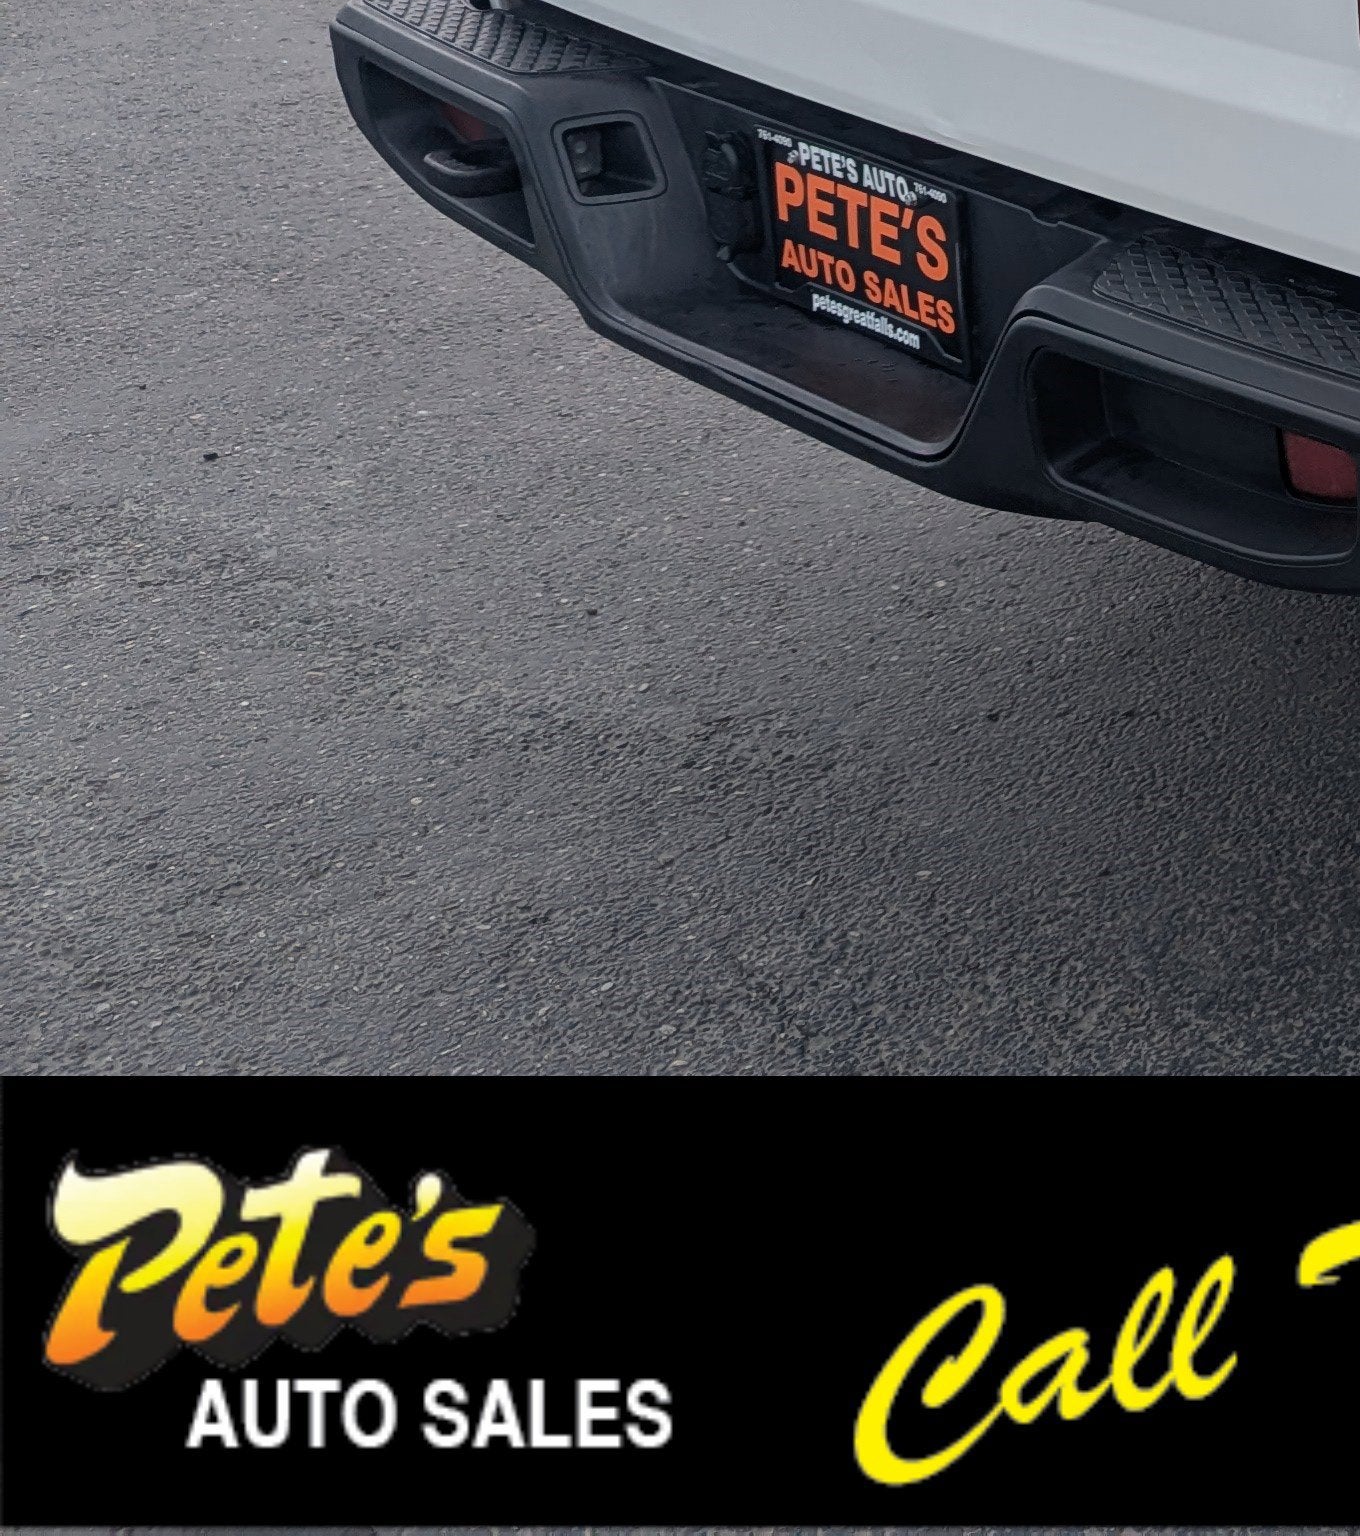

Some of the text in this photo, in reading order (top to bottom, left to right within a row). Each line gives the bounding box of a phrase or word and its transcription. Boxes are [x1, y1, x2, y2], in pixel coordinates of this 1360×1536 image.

[799, 141, 859, 184] PETE'S
[862, 164, 909, 202] AUTO
[774, 160, 950, 282] PETE'S
[781, 239, 956, 335] AUTO SALES
[811, 292, 921, 351] petesgreatfalls.com
